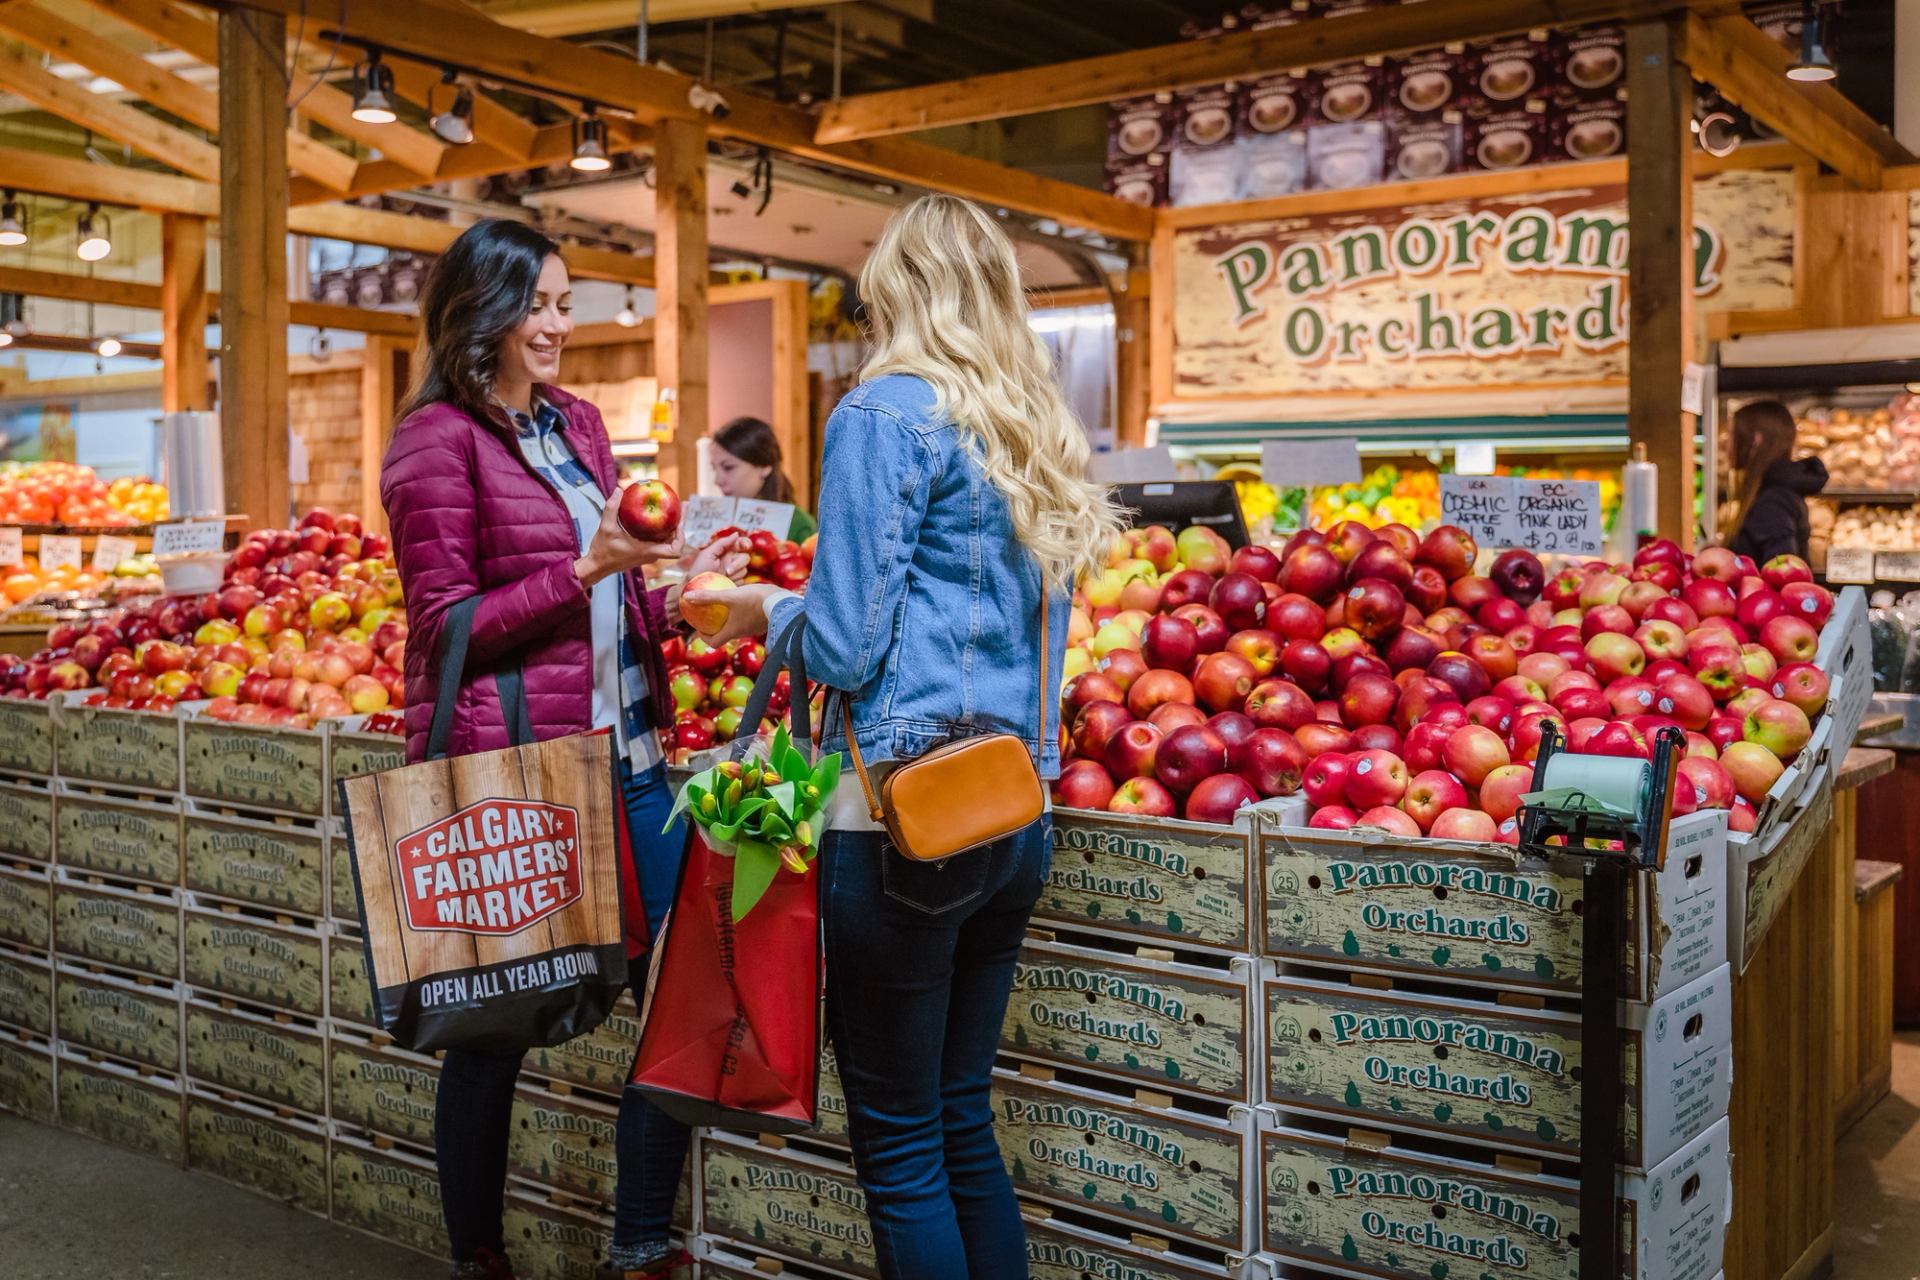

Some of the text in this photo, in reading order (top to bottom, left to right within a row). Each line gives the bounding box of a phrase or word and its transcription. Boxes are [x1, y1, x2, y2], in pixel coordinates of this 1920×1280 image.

[1284, 284, 1629, 364] Orchard
[1442, 492, 1510, 514] COSMIC
[1455, 513, 1502, 526] APPLE
[1515, 513, 1588, 530] PINK LADY
[1518, 496, 1588, 512] ORGANIC
[210, 735, 298, 767] Panorama
[223, 763, 285, 785] Orchards
[210, 831, 298, 866] Panorama
[427, 806, 556, 858] CALGARY
[412, 837, 574, 900] FARMERS'
[1051, 826, 1190, 877] norama
[223, 858, 286, 884] Orchards
[1048, 866, 1164, 904] rchards
[1278, 875, 1294, 890] 25
[1326, 858, 1563, 914] Panorama
[436, 876, 568, 927] MARKET
[1361, 902, 1532, 947] Orchards
[210, 926, 298, 967] Panorama
[223, 955, 285, 983] Orchards
[420, 976, 468, 1008] OPEN
[472, 972, 504, 1000] ALL
[505, 964, 551, 993] YEAR
[1011, 960, 1188, 1025] Panorama
[210, 1020, 298, 1063] Panorama
[1029, 1000, 1163, 1049] Orchards
[1280, 1023, 1296, 1038] 25
[1328, 1010, 1565, 1077] Panorama
[555, 1037, 635, 1068] rchards
[360, 1059, 438, 1093] Panora
[1363, 1054, 1533, 1107] Orchards
[374, 1088, 436, 1120] Orchar
[533, 1107, 616, 1143] Panora
[1003, 1096, 1186, 1170] Panorama
[551, 1139, 617, 1178] Orchar
[1028, 1135, 1160, 1190] Orchards
[363, 1162, 441, 1199] Panora
[744, 1164, 868, 1214] Panoram
[1277, 1172, 1293, 1189] 25
[378, 1190, 447, 1228] Orchard
[1326, 1165, 1562, 1241] Panorama
[537, 1218, 610, 1250] Panor
[766, 1199, 874, 1247] Orchards
[1360, 1210, 1529, 1270] Orchards
[1027, 1243, 1156, 1280] anora
